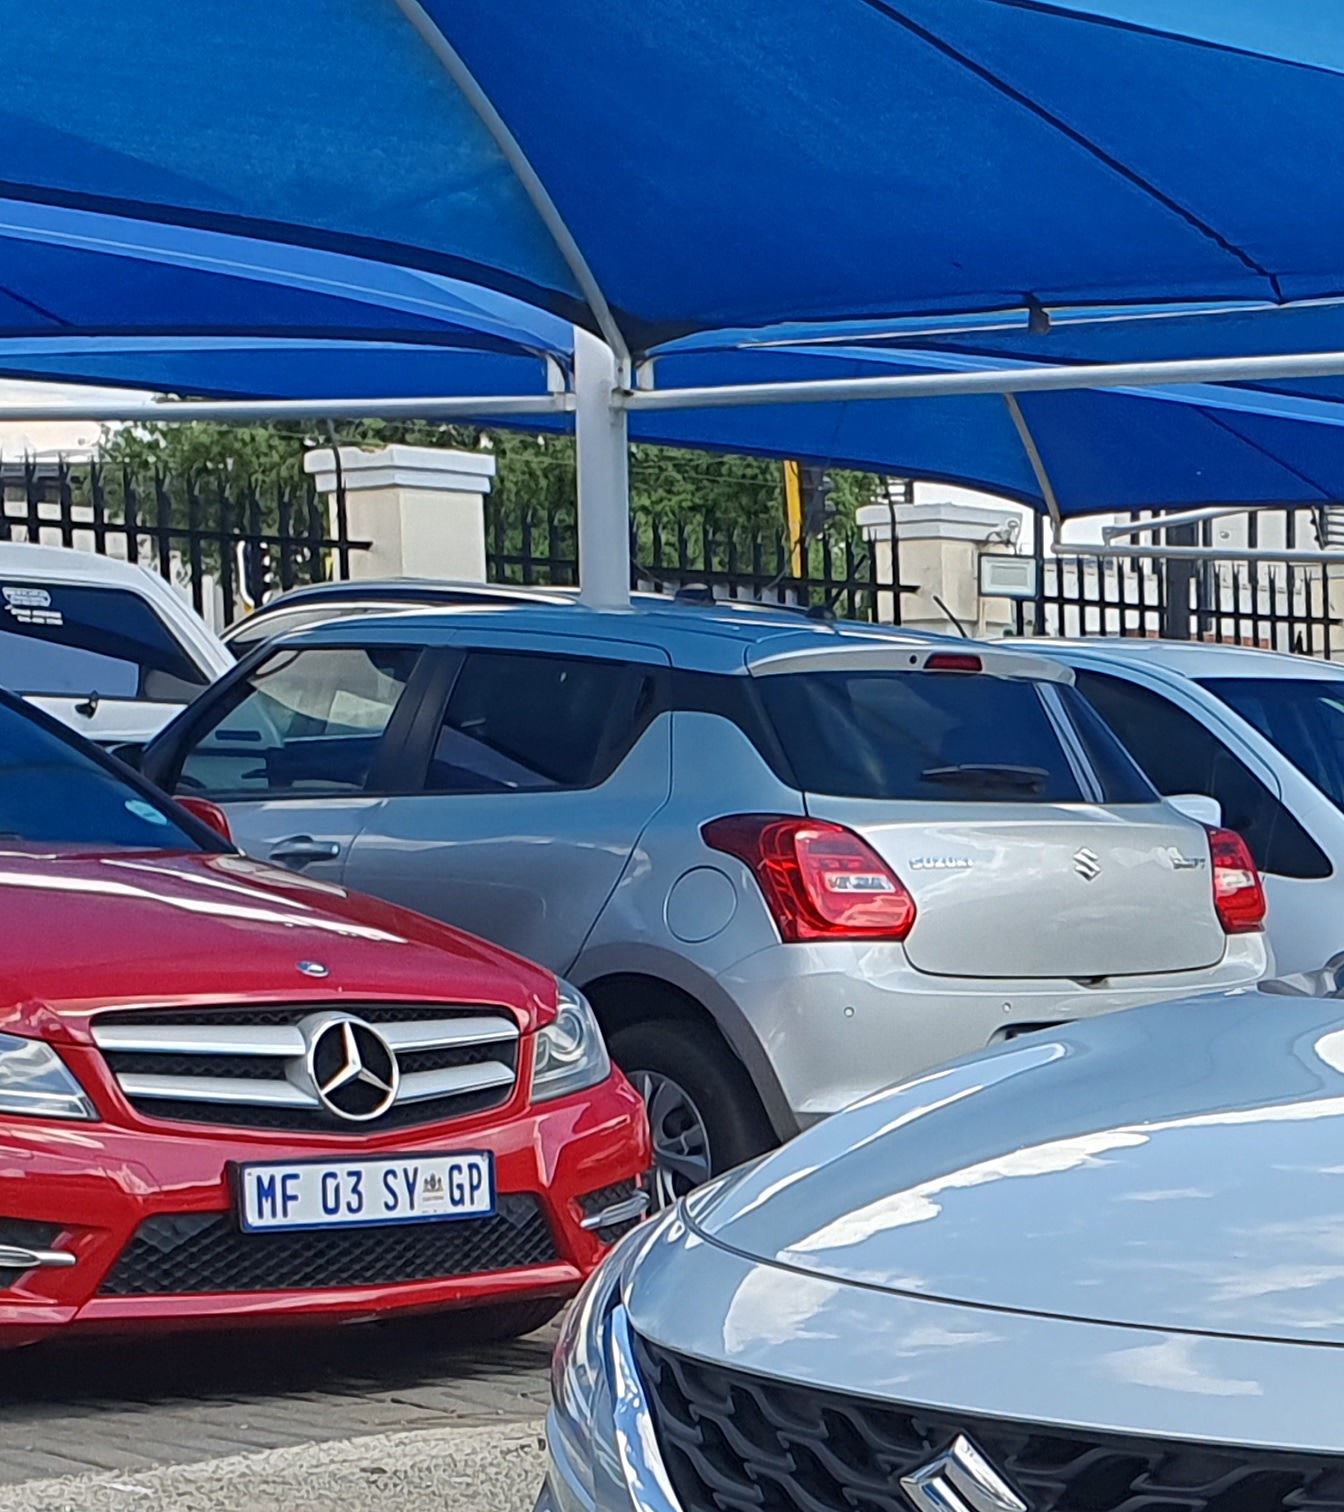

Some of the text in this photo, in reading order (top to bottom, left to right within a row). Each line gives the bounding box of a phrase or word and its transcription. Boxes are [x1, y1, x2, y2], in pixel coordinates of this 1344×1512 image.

[256, 1162, 482, 1219] MF 03 SY GP
